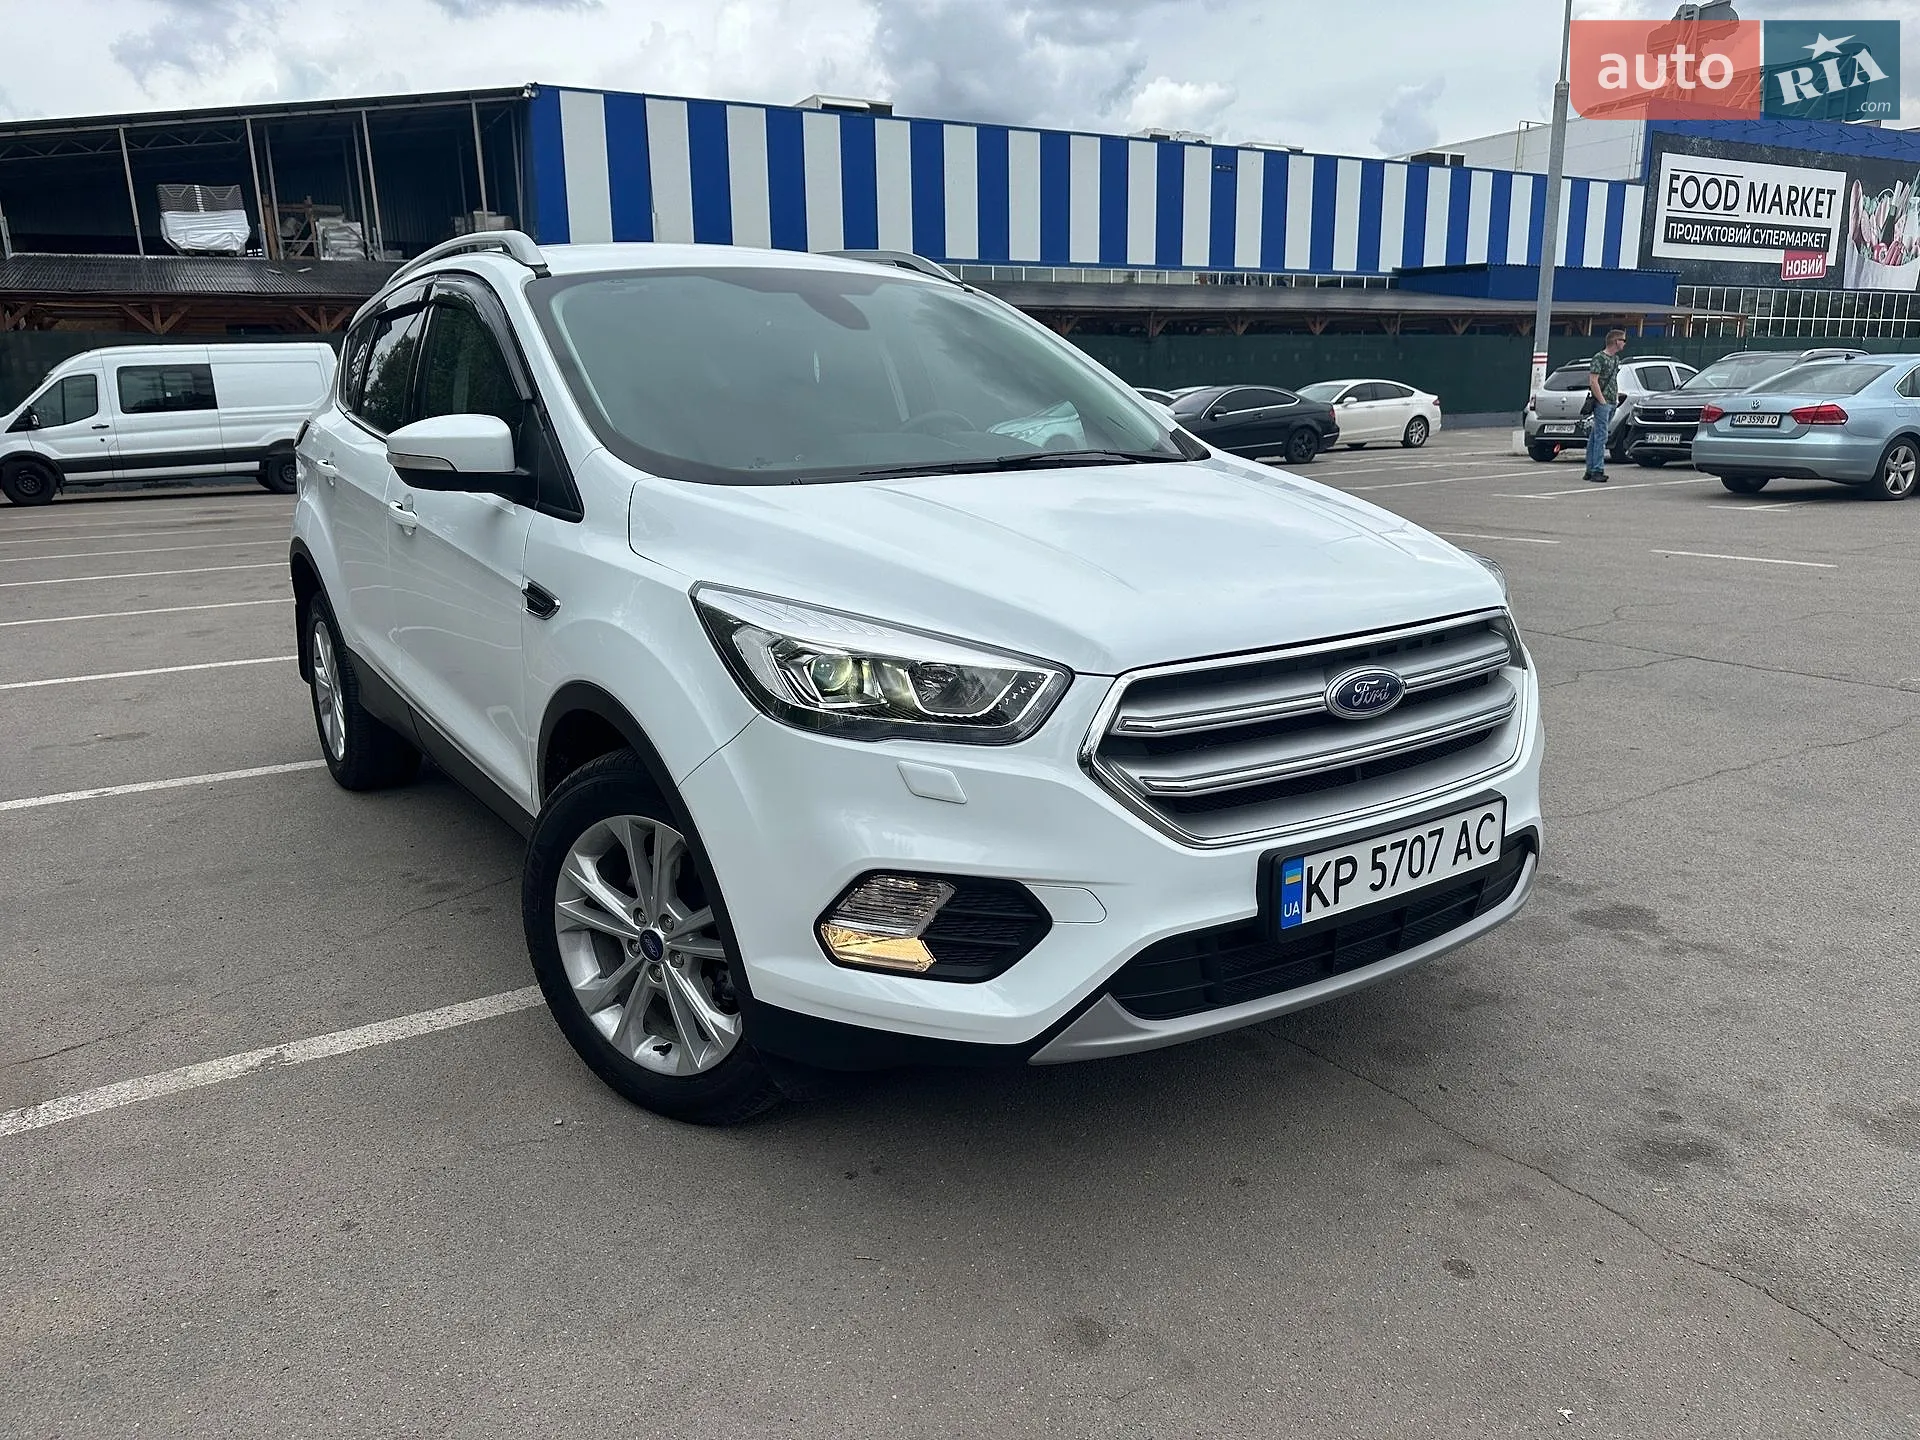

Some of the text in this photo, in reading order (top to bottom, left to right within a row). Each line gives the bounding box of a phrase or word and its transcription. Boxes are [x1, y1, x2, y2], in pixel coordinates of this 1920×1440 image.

[1667, 173, 1837, 219] FOOD MARKET
[1668, 222, 1827, 248] ПРОДУКТОВИЙ СУПЕРМАРКЕТ
[1785, 255, 1824, 276] НОВИЙ
[1736, 415, 1747, 424] AP
[1352, 680, 1390, 707] Ford
[1305, 812, 1496, 913] KP 5707 AC
[1284, 901, 1300, 917] UA
